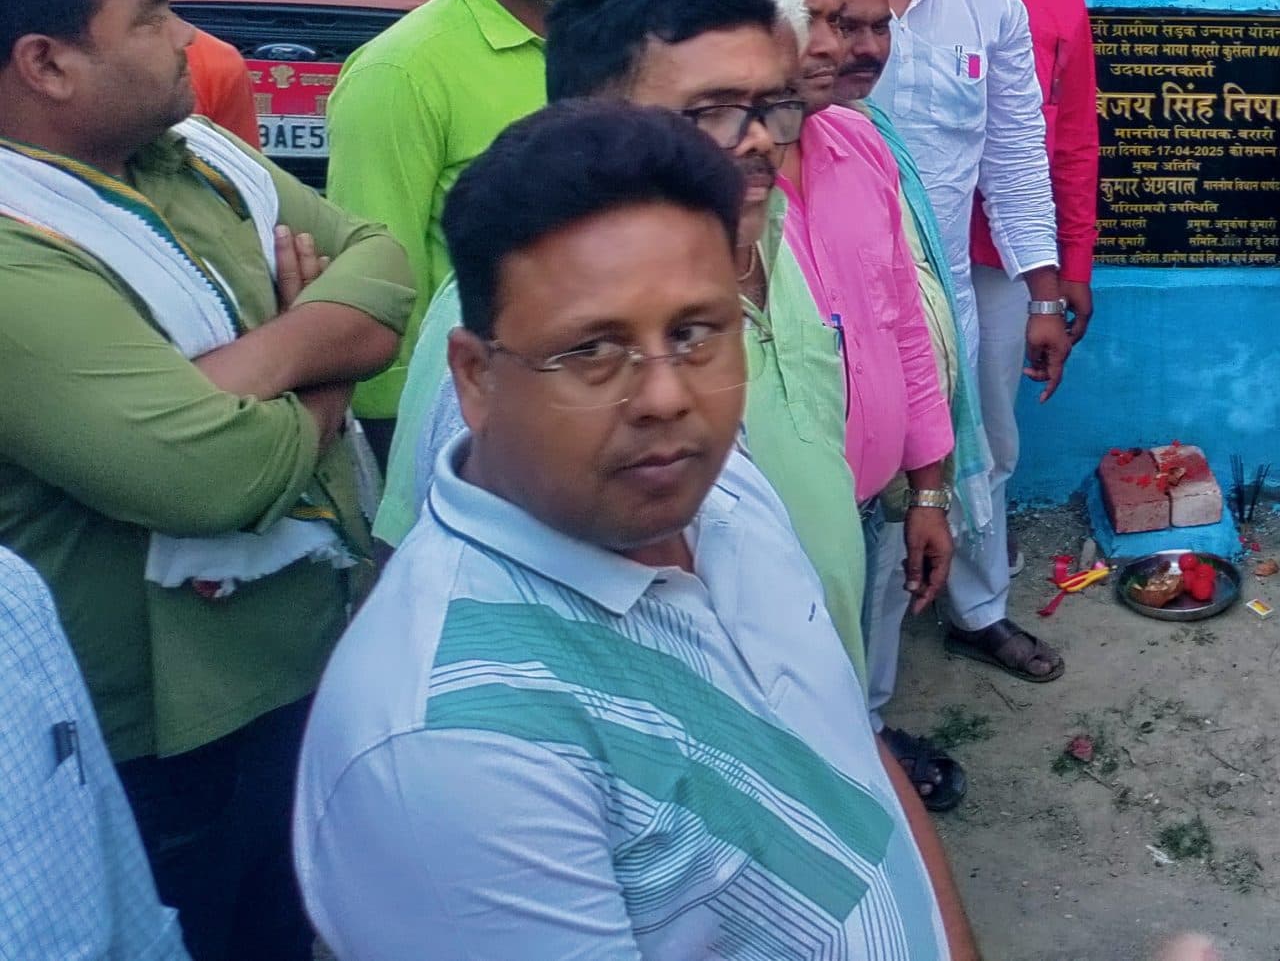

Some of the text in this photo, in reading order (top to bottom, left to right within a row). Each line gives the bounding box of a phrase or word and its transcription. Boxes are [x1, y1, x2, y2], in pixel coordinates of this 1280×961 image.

[1112, 20, 1159, 37] ग्रामीण
[1162, 24, 1197, 39] सड़क
[1200, 25, 1245, 38] उन्नयन
[1161, 81, 1217, 124] सिंह
[1115, 125, 1171, 139] माननीय
[1132, 161, 1159, 174] मुख्य
[1100, 178, 1140, 202] कुमार
[1142, 177, 1198, 195] अग्रवाल
